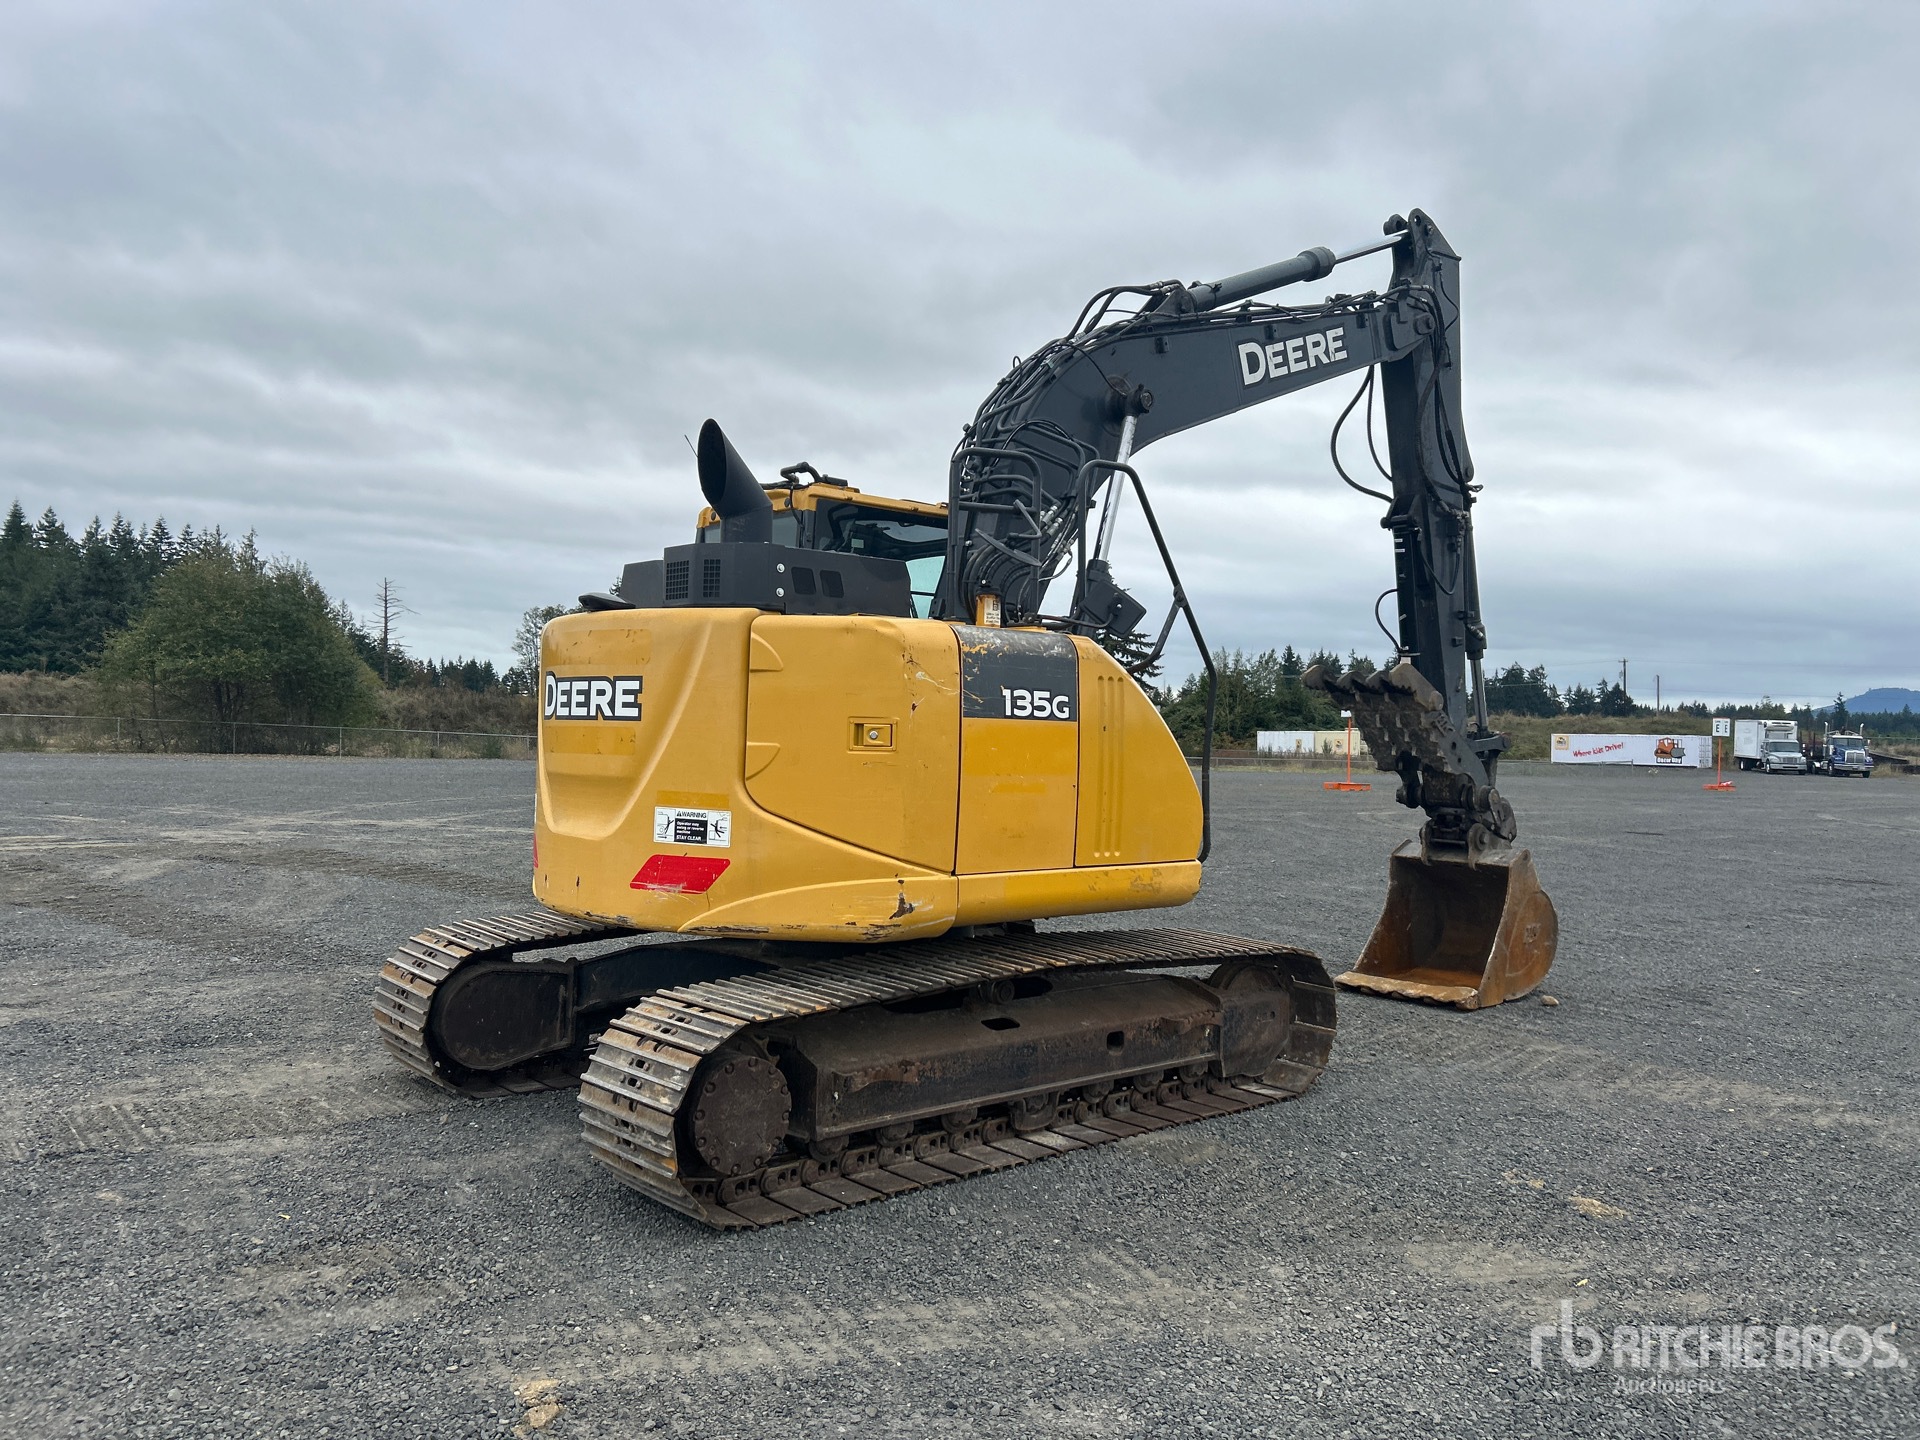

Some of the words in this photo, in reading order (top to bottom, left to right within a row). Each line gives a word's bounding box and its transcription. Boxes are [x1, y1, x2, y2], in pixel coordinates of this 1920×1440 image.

[1238, 326, 1348, 386] DEERE
[544, 675, 640, 717] DEERE
[1002, 688, 1070, 719] 135G
